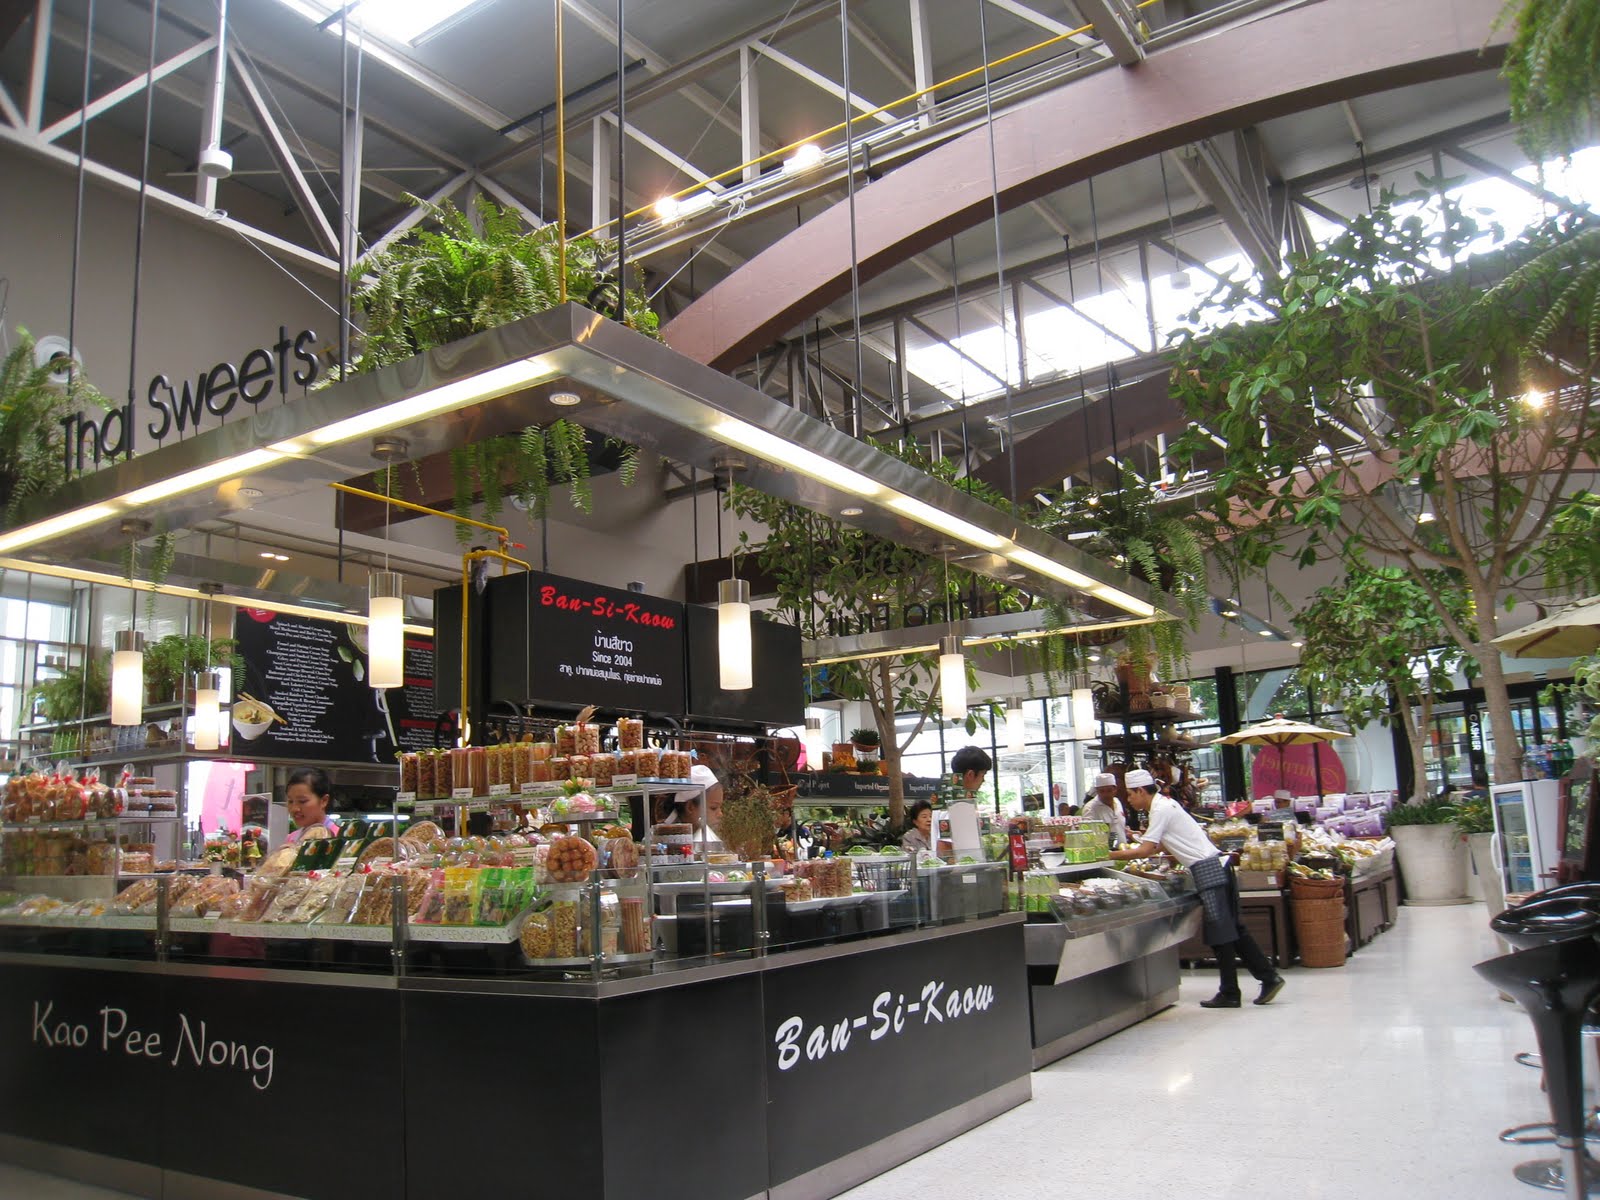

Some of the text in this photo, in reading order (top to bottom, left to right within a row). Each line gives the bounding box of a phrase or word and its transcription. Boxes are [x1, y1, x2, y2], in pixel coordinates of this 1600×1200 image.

[148, 326, 319, 440] Sweets
[539, 585, 675, 629] Ban-Si-Kaow
[592, 651, 632, 667] Since 2004
[1469, 714, 1482, 751] CASHIER
[32, 1000, 274, 1090] Kao Pee Nong
[774, 980, 994, 1070] Ban-Si-Kaow
